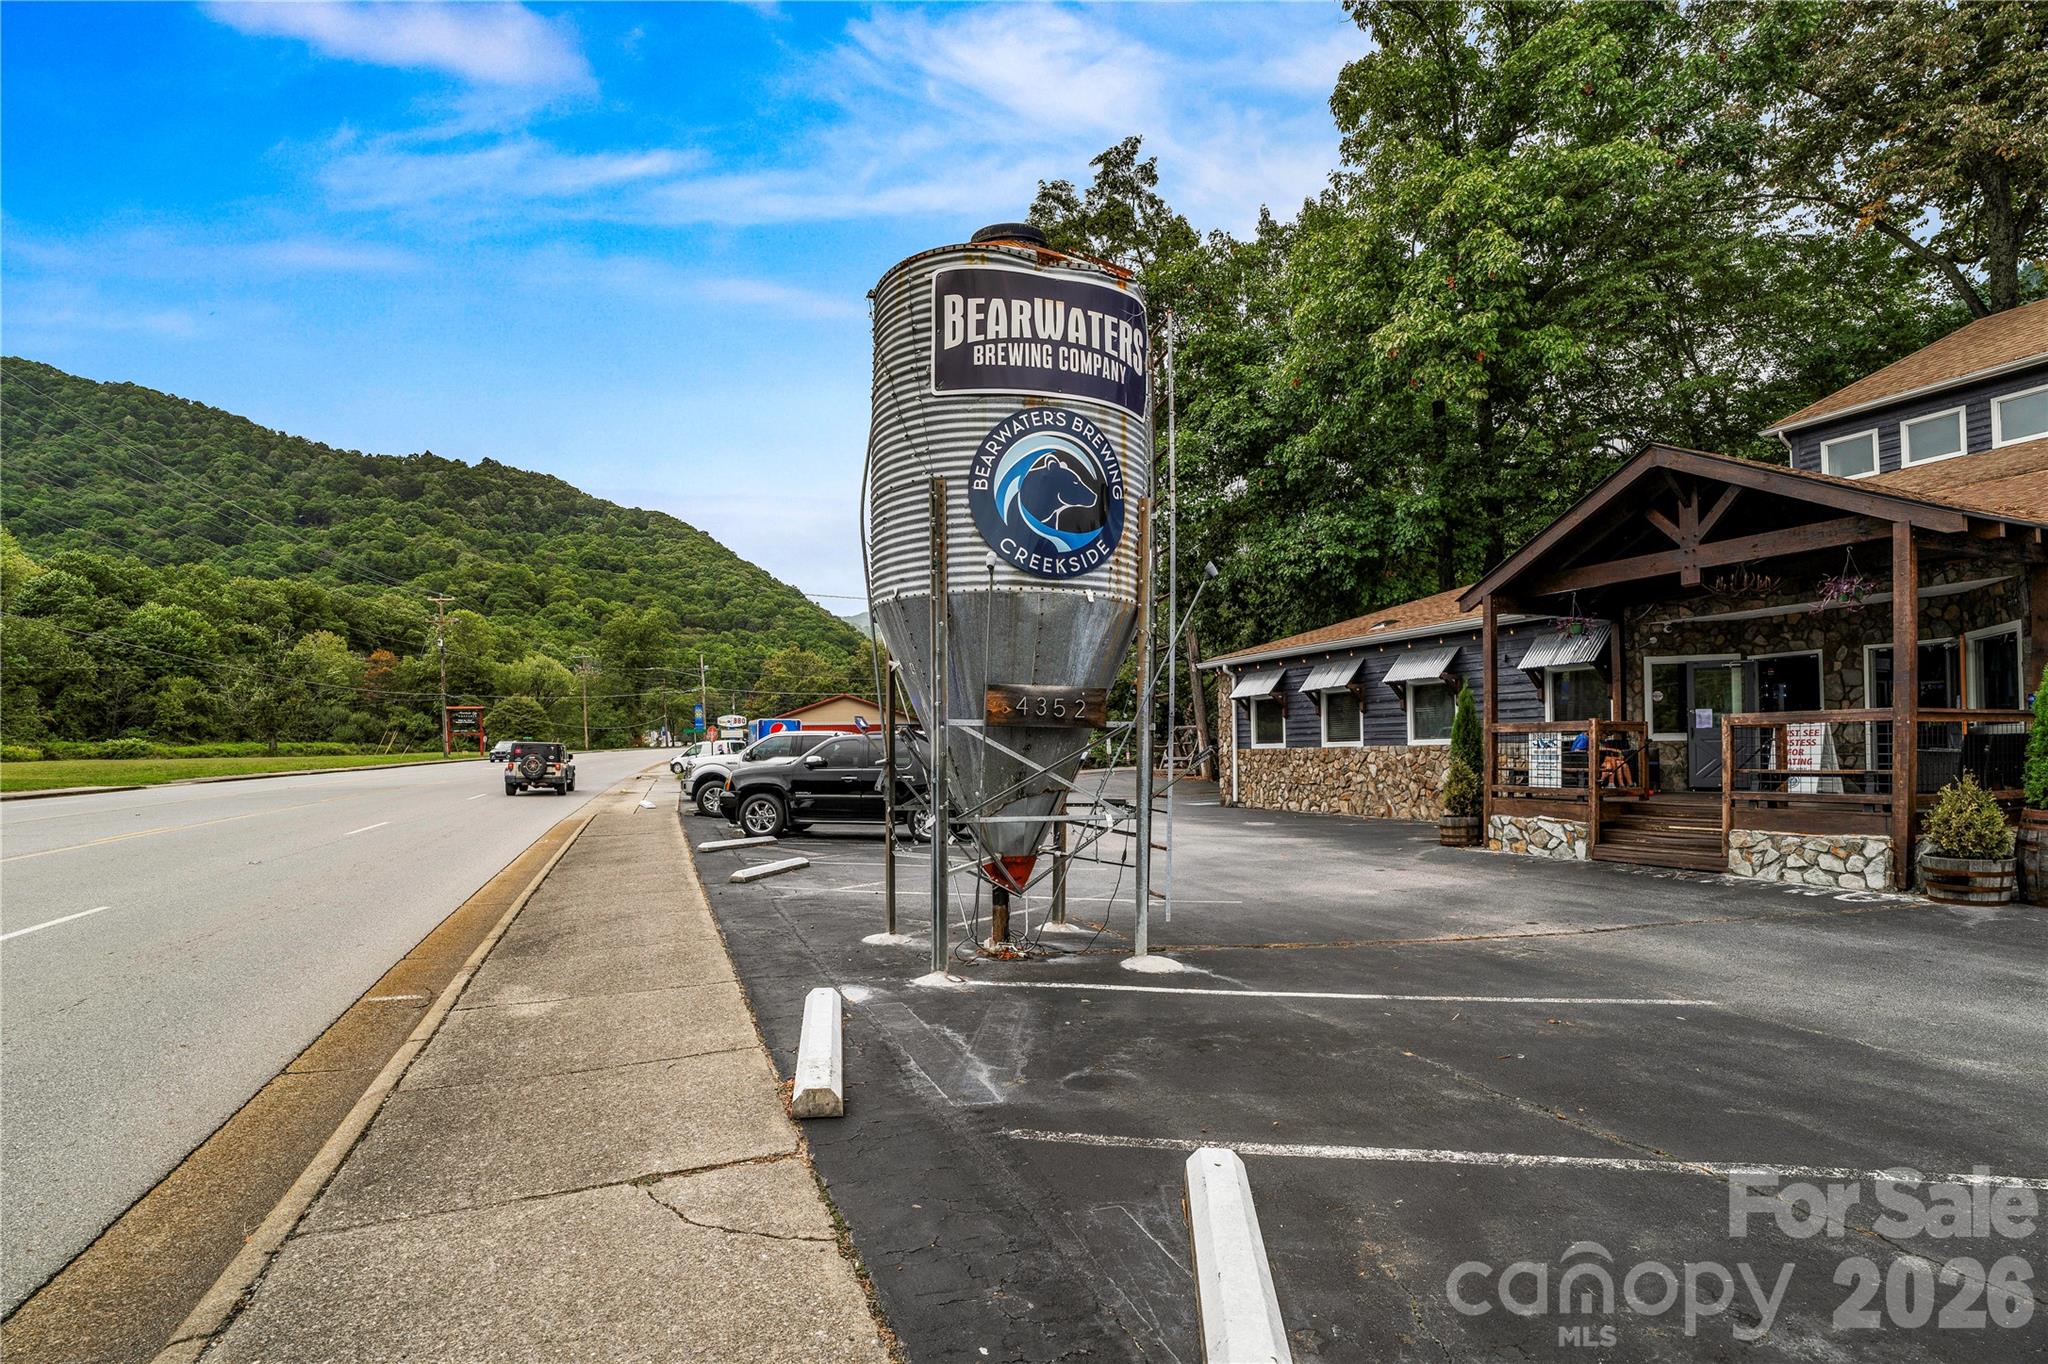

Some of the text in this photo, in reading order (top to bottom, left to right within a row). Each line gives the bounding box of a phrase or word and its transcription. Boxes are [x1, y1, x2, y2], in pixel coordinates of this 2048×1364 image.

[944, 294, 1144, 377] BEARWATERS
[973, 342, 1127, 384] BREWING COMPANY
[974, 411, 1123, 500] BEARWATERS BREWING
[1000, 538, 1110, 574] CREEKSIDE
[1016, 696, 1086, 718] 4352
